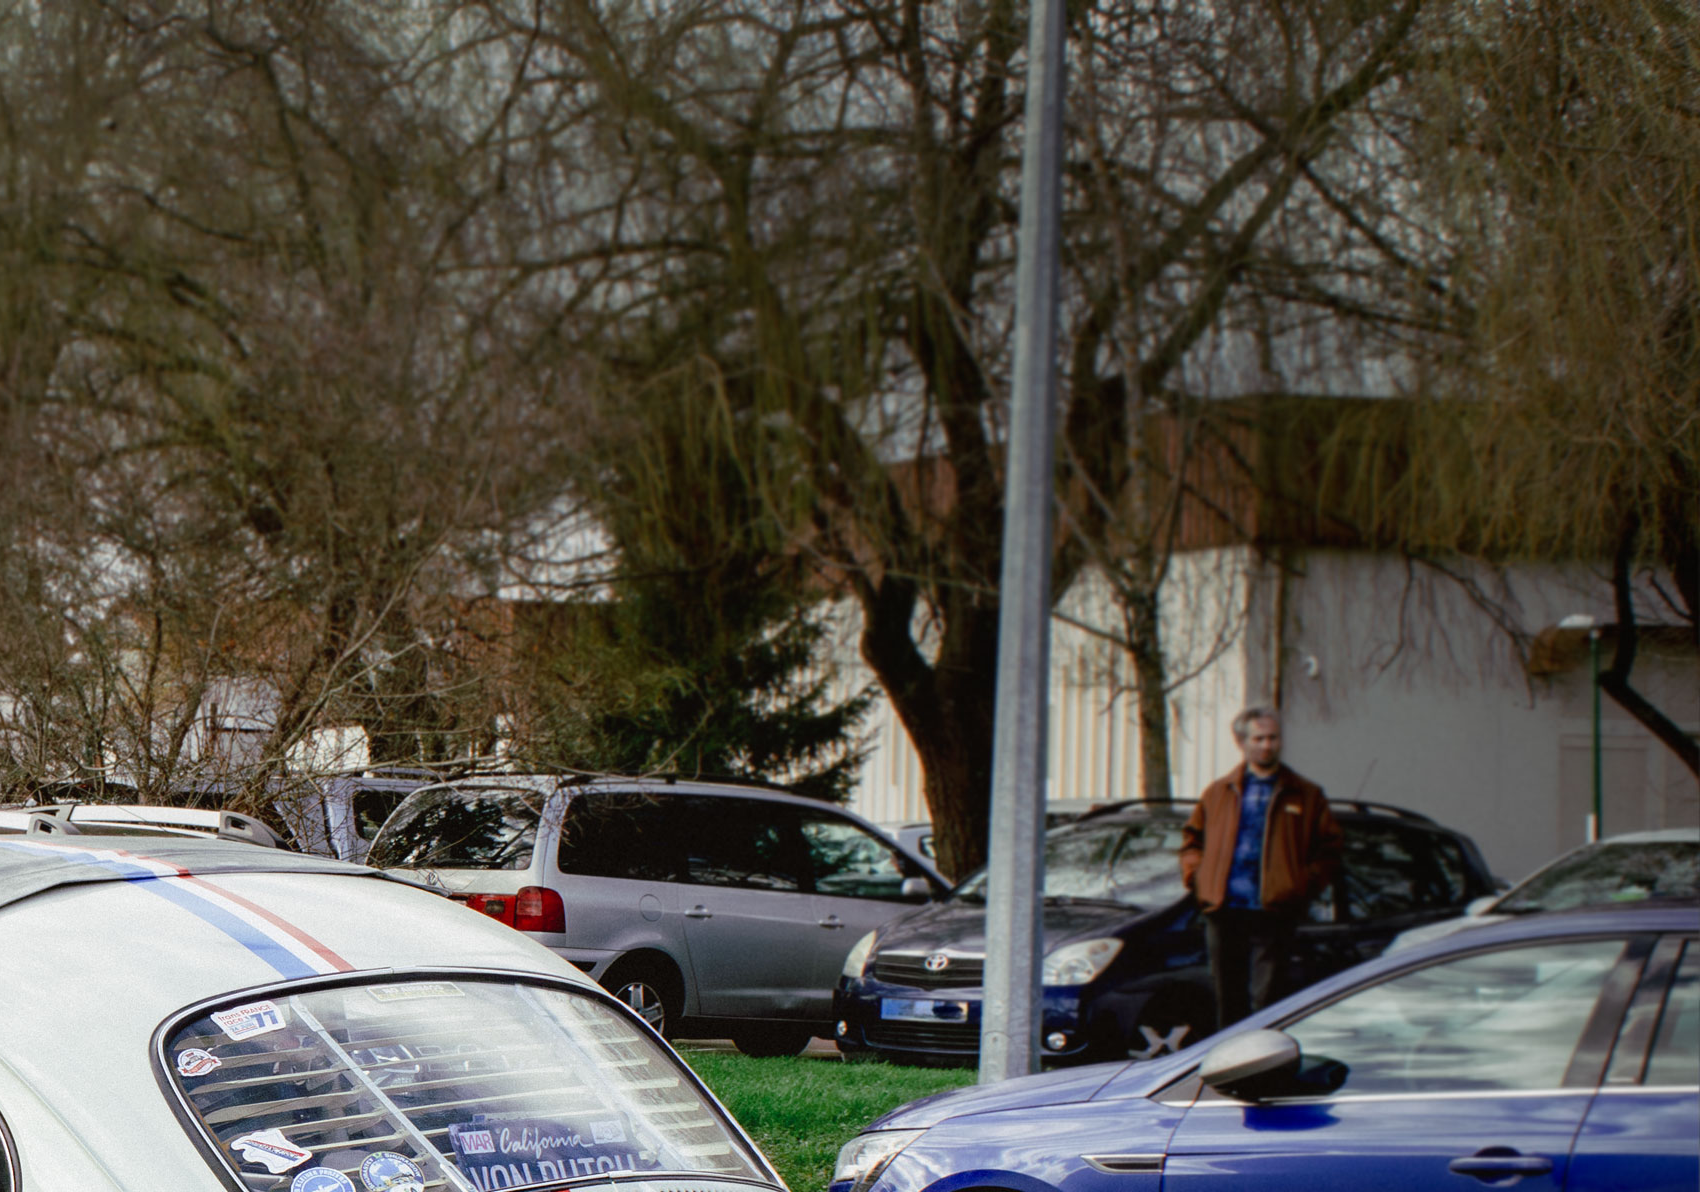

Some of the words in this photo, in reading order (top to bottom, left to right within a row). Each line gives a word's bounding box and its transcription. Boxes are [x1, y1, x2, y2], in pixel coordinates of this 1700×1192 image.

[240, 1004, 272, 1015] FRANCE
[460, 1133, 494, 1151] MAR
[500, 1127, 594, 1159] California
